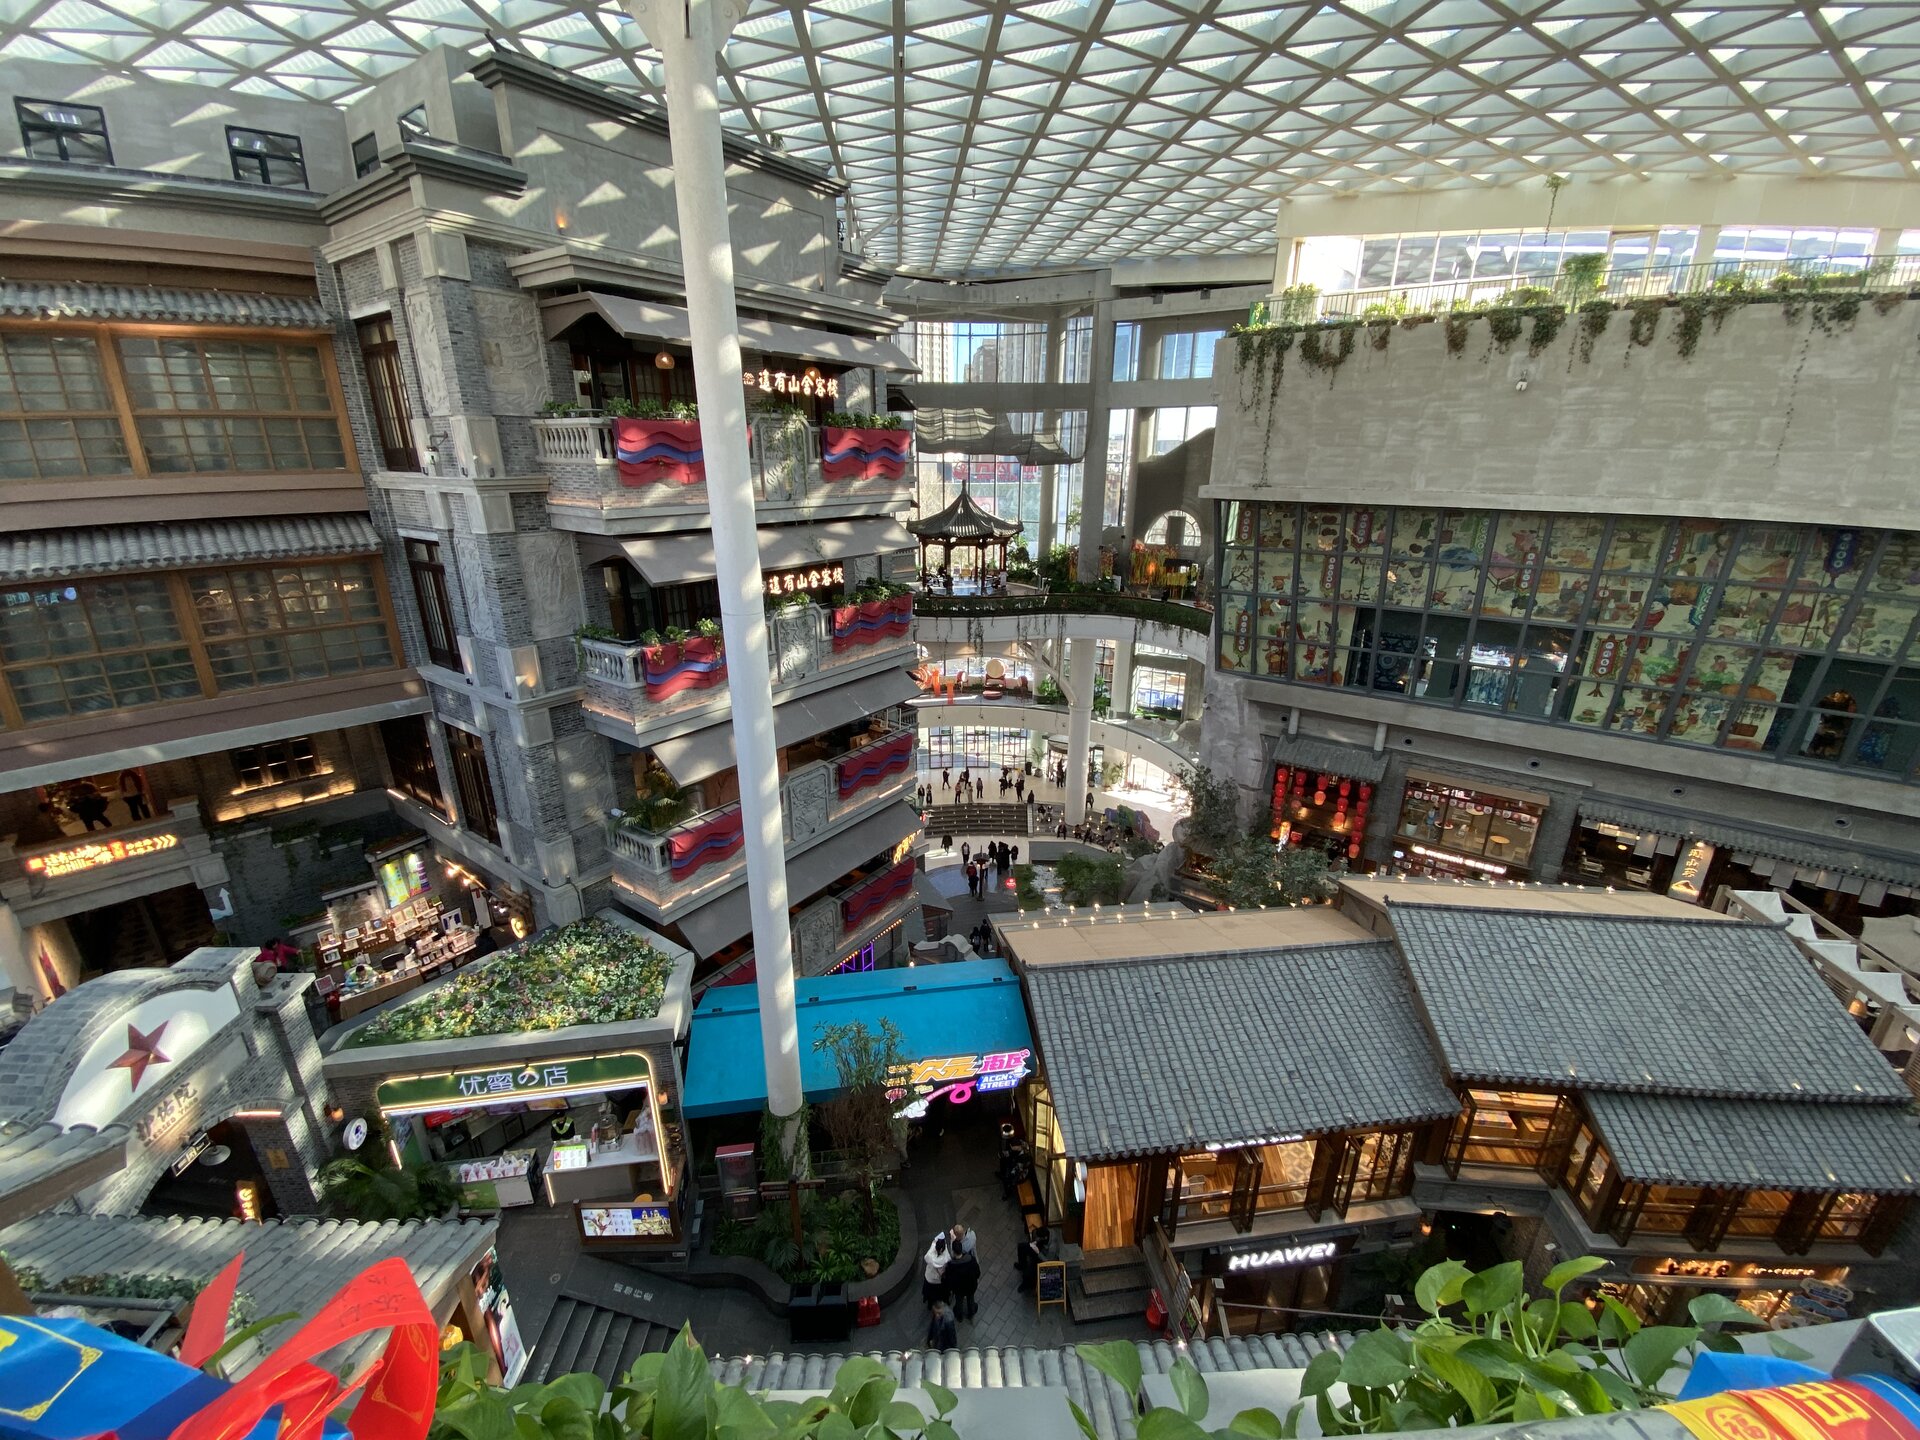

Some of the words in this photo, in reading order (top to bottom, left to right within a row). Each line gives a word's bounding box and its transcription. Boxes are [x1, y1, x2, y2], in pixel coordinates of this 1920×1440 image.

[459, 1066, 568, 1097] 优蜜の店
[980, 1079, 1017, 1090] STREET
[1228, 1242, 1336, 1271] HUAWEI
